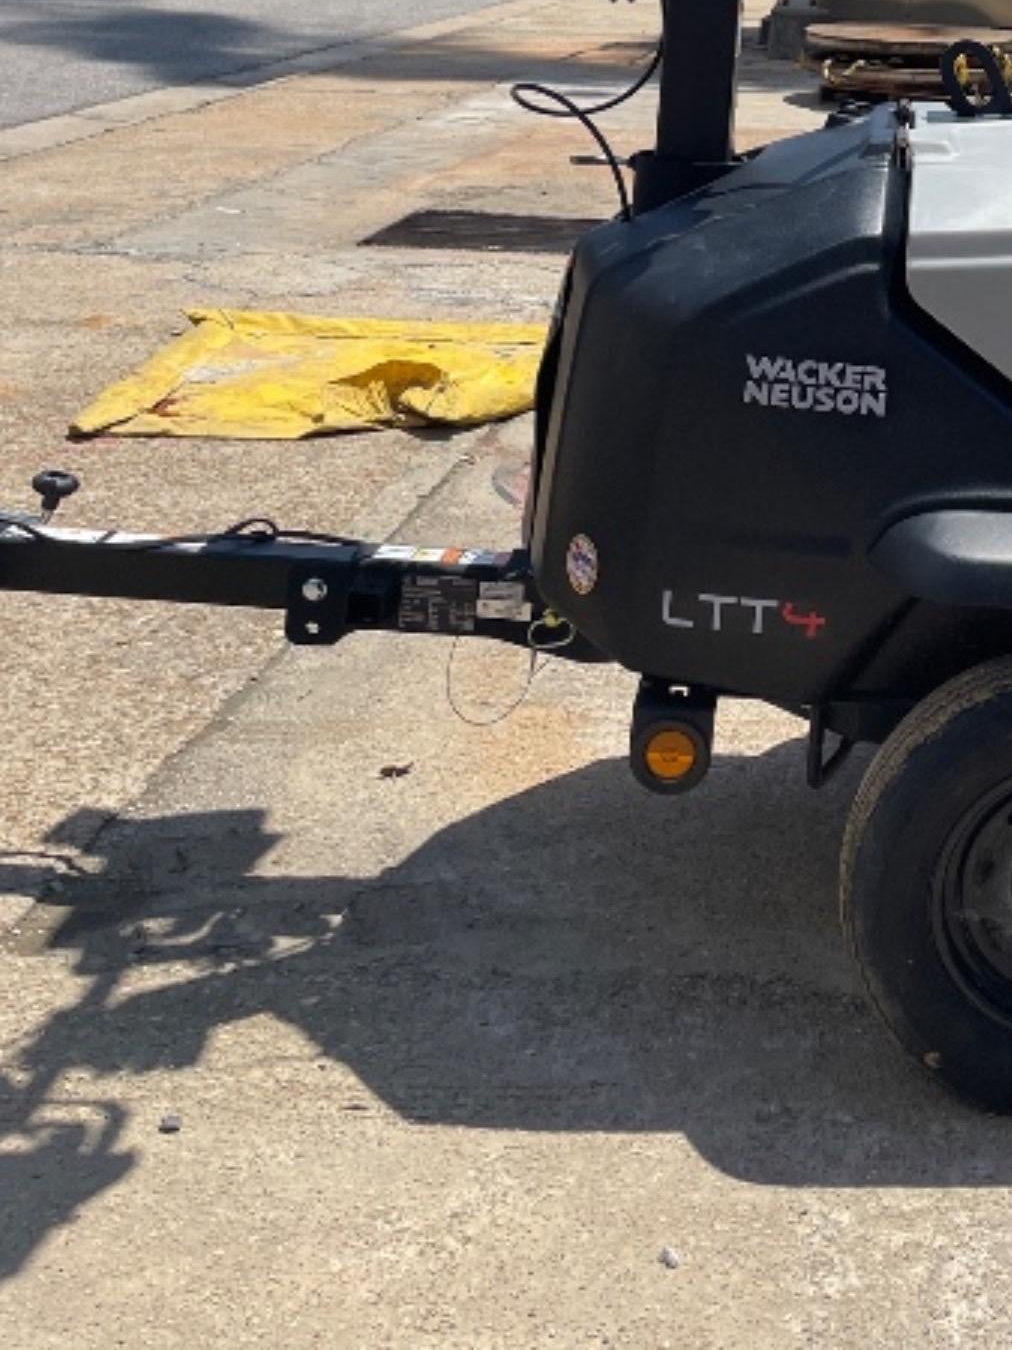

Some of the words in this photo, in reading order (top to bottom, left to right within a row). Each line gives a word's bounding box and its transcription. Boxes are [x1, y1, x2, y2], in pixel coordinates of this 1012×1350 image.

[745, 353, 888, 392] WACKER
[742, 379, 887, 418] NEUSON
[661, 589, 826, 639] LTT4
